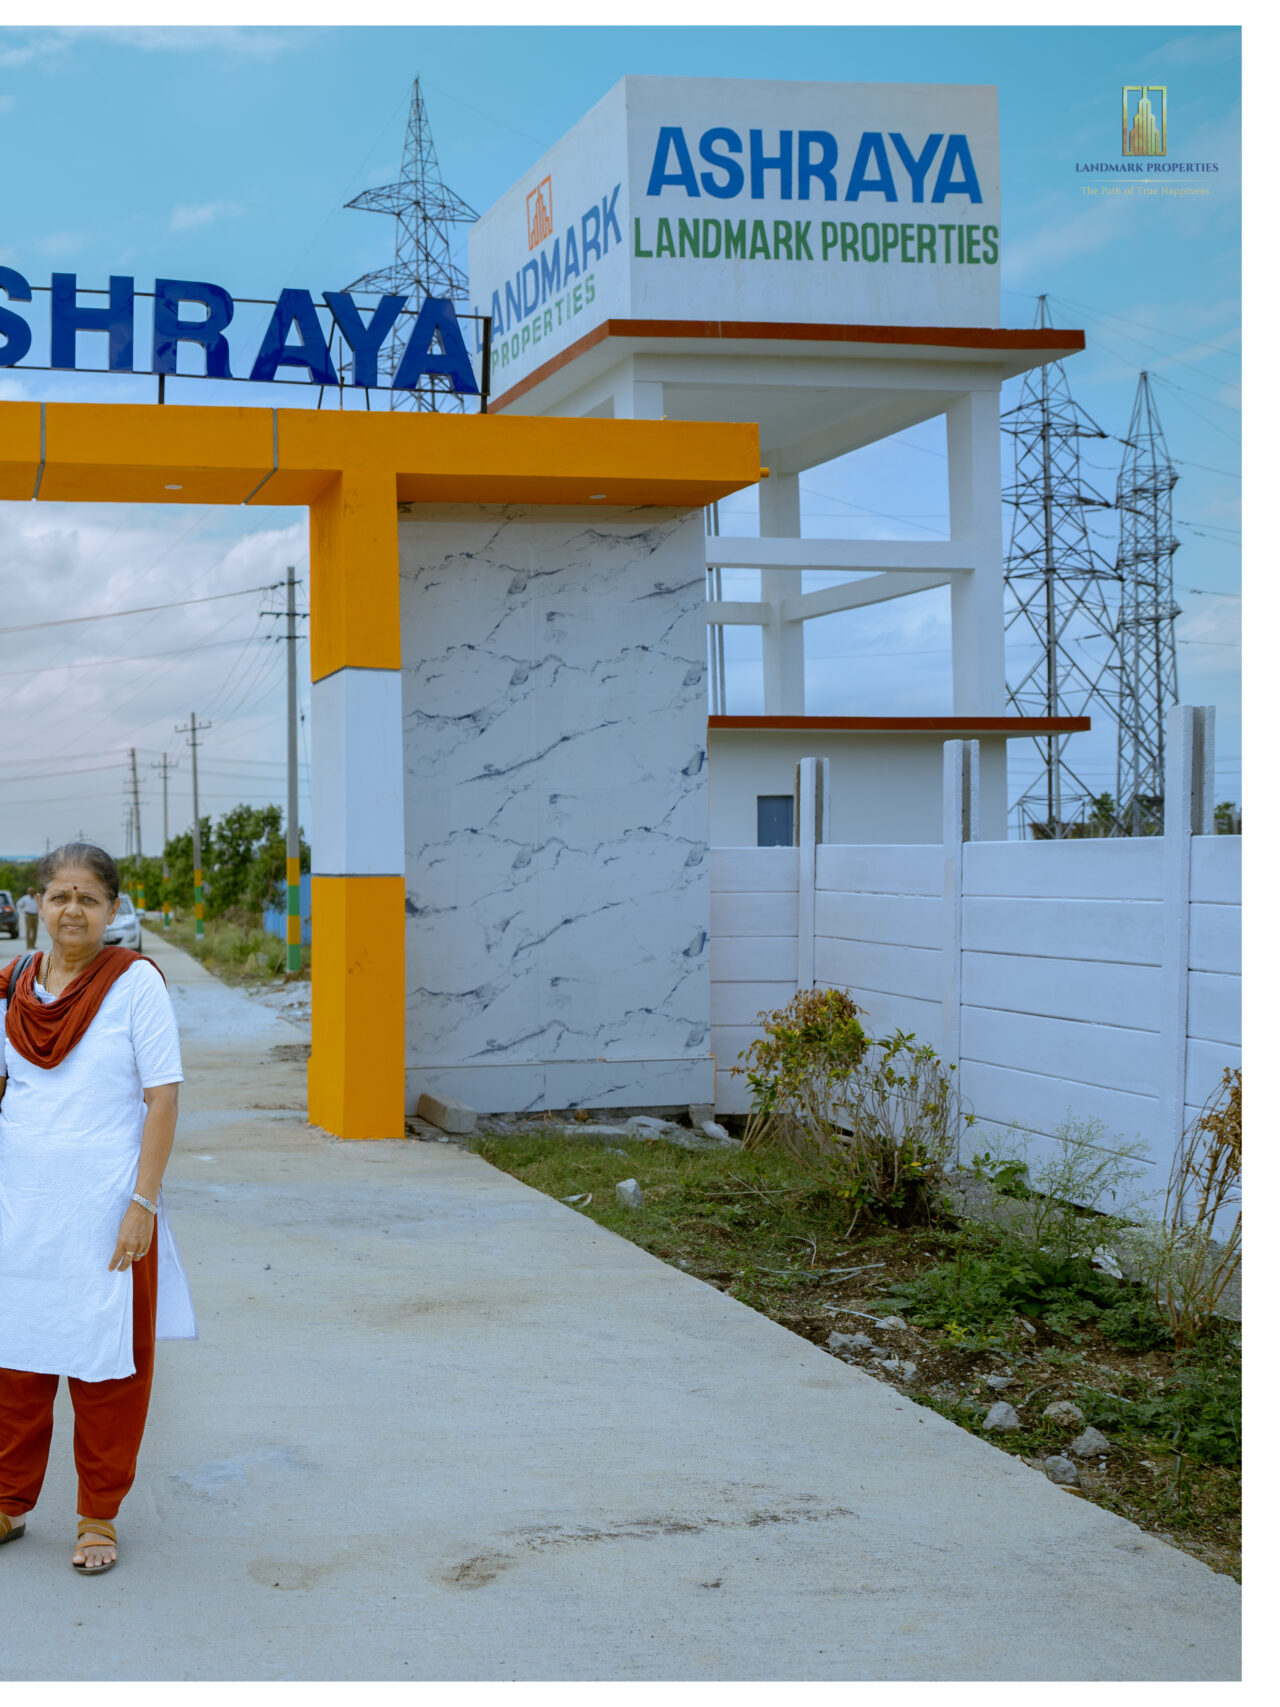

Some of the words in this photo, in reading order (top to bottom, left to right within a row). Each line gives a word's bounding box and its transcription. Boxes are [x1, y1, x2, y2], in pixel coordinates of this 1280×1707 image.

[646, 126, 984, 204] ASHRAYA
[474, 183, 622, 355] LANDMARK
[634, 217, 815, 261] LANDMARK
[821, 221, 999, 265] PROPERTIES
[491, 273, 596, 376] PROPERTIES
